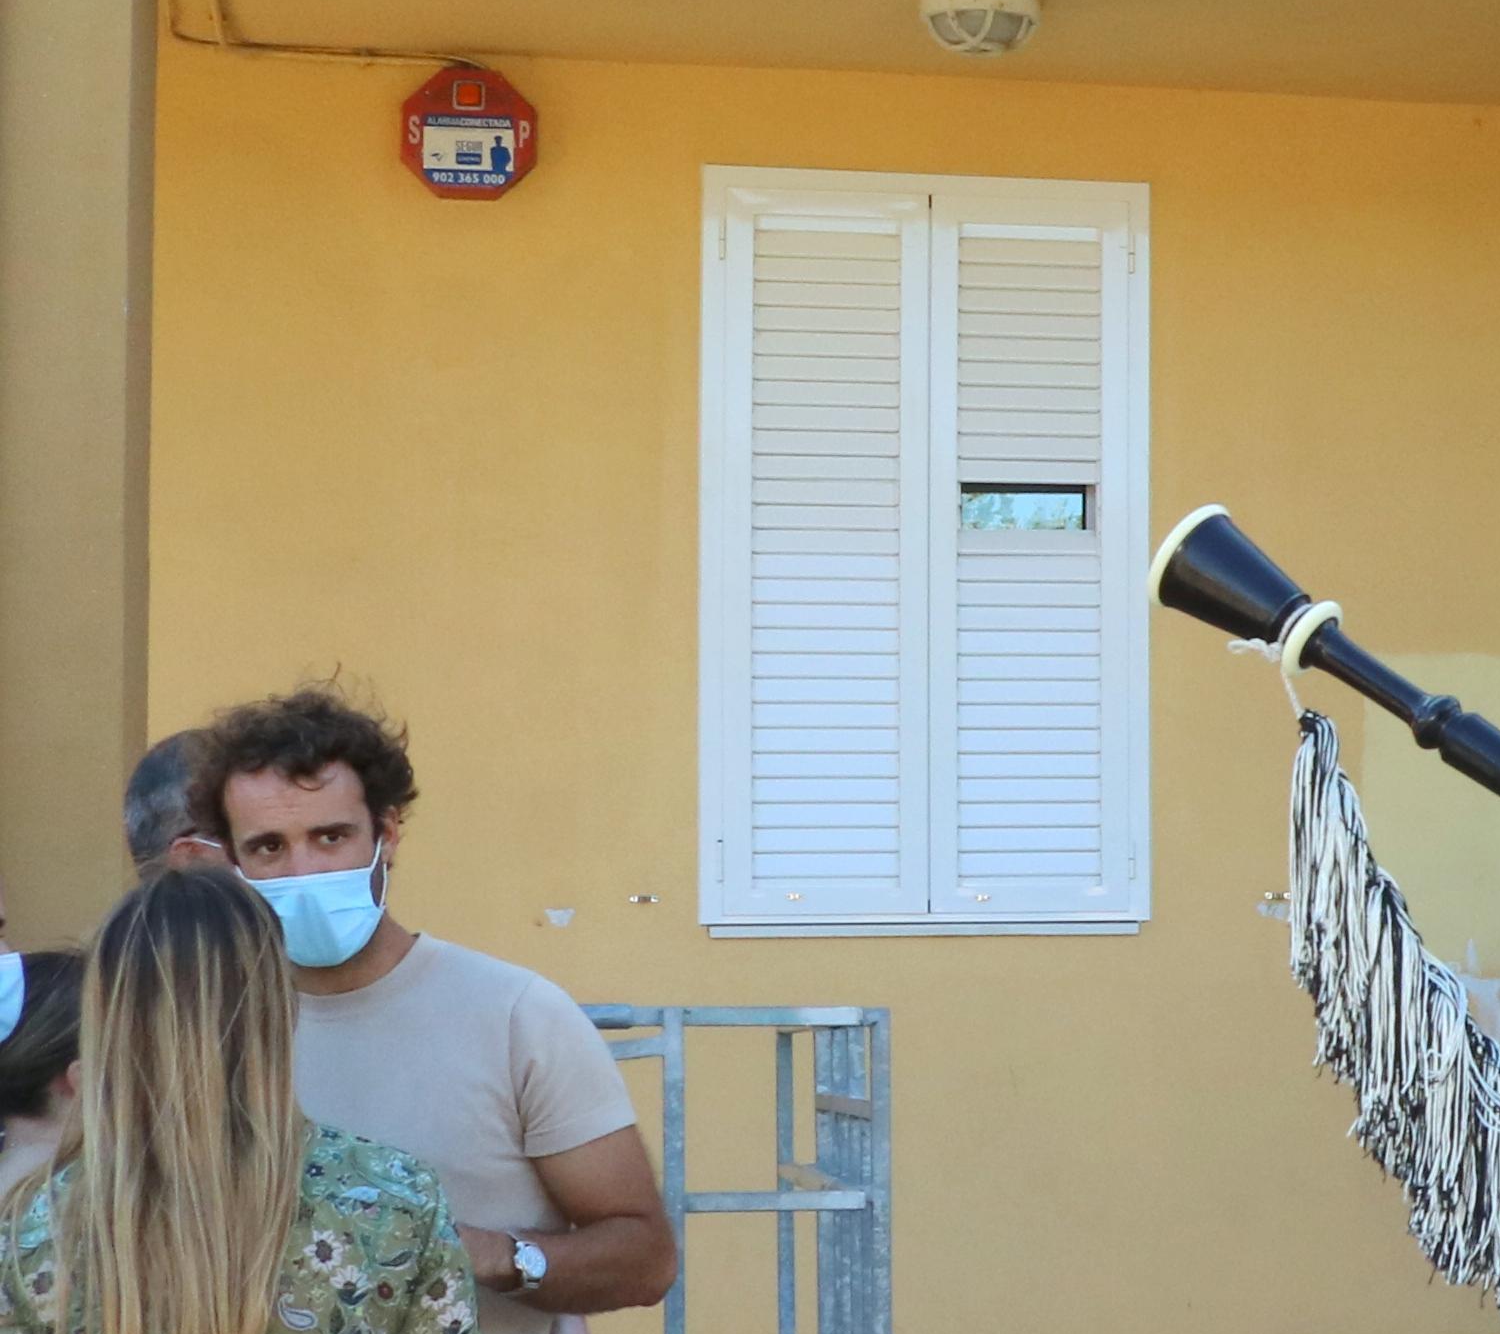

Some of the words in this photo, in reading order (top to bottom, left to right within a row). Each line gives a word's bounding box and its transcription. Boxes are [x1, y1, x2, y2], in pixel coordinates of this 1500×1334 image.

[432, 172, 454, 183] 902
[458, 173, 480, 183] 365
[483, 174, 505, 184] 000
